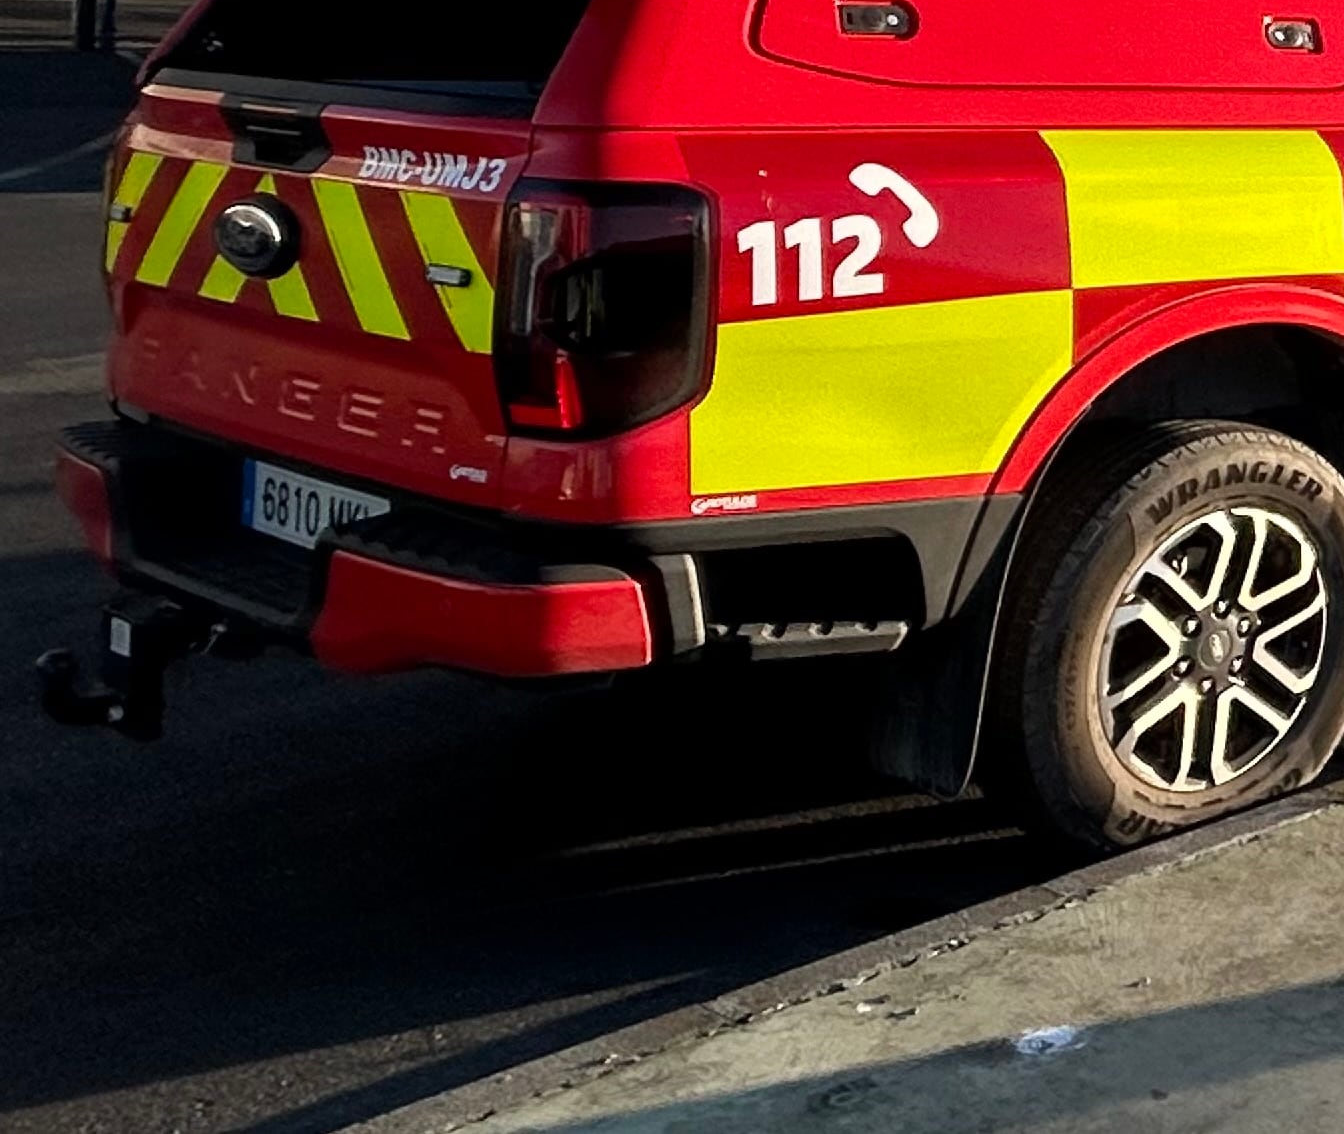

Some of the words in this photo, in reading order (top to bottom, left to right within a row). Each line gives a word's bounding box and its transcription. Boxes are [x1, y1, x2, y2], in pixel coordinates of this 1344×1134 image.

[358, 144, 507, 193] BMC-UMJ3
[736, 213, 885, 307] 112
[262, 476, 320, 537] 6810
[1144, 460, 1325, 526] WRANGLER
